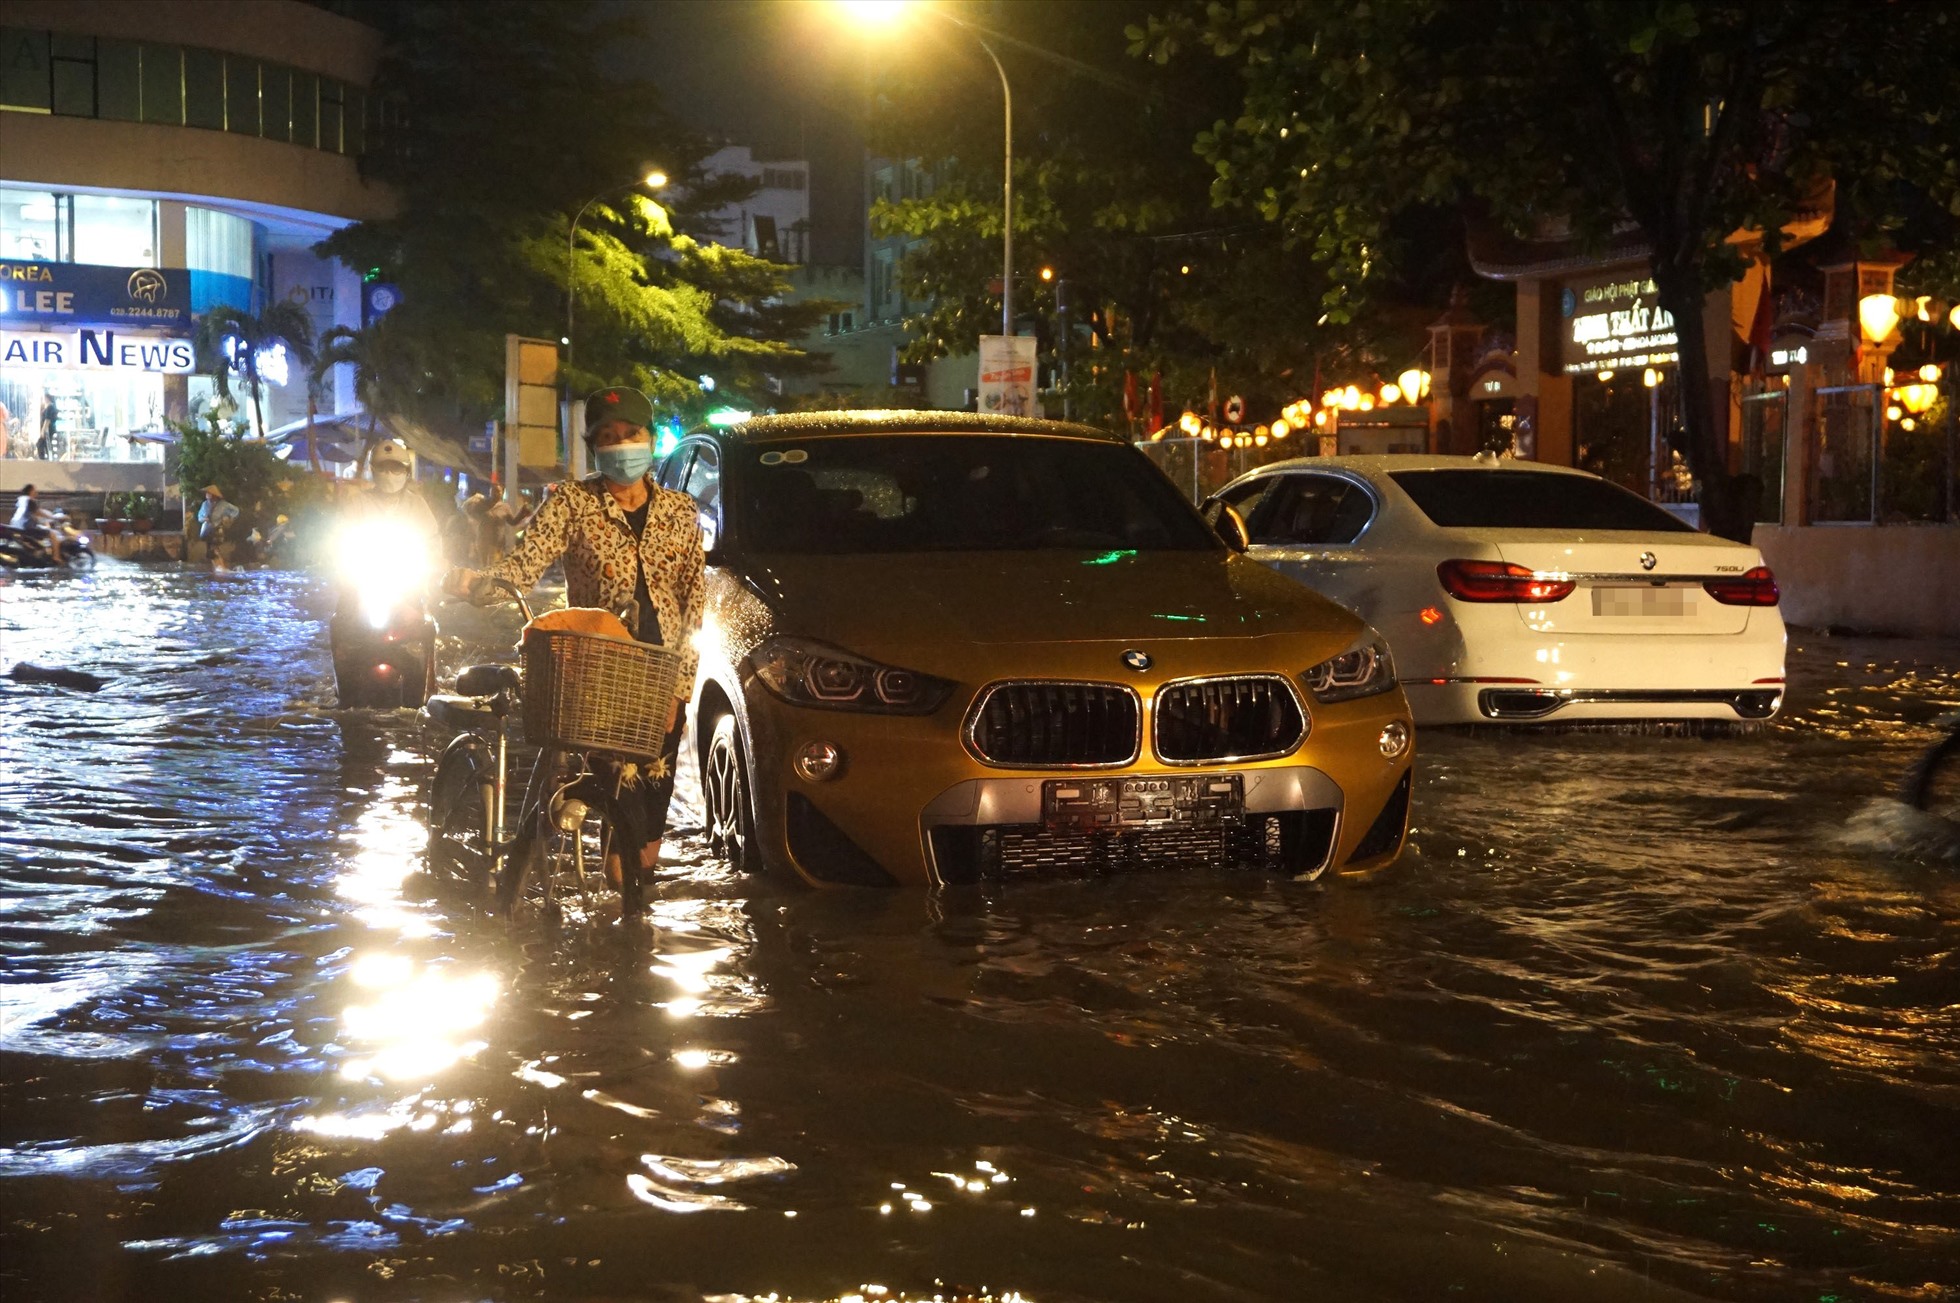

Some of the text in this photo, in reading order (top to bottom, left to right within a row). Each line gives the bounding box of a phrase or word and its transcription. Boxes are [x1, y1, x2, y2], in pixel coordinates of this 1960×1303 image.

[1640, 277, 1659, 294] GIÁ
[17, 290, 74, 313] LEE
[110, 306, 180, 319] 028.2244.8787
[1610, 298, 1649, 336] THẤT
[4, 340, 63, 363] AIR
